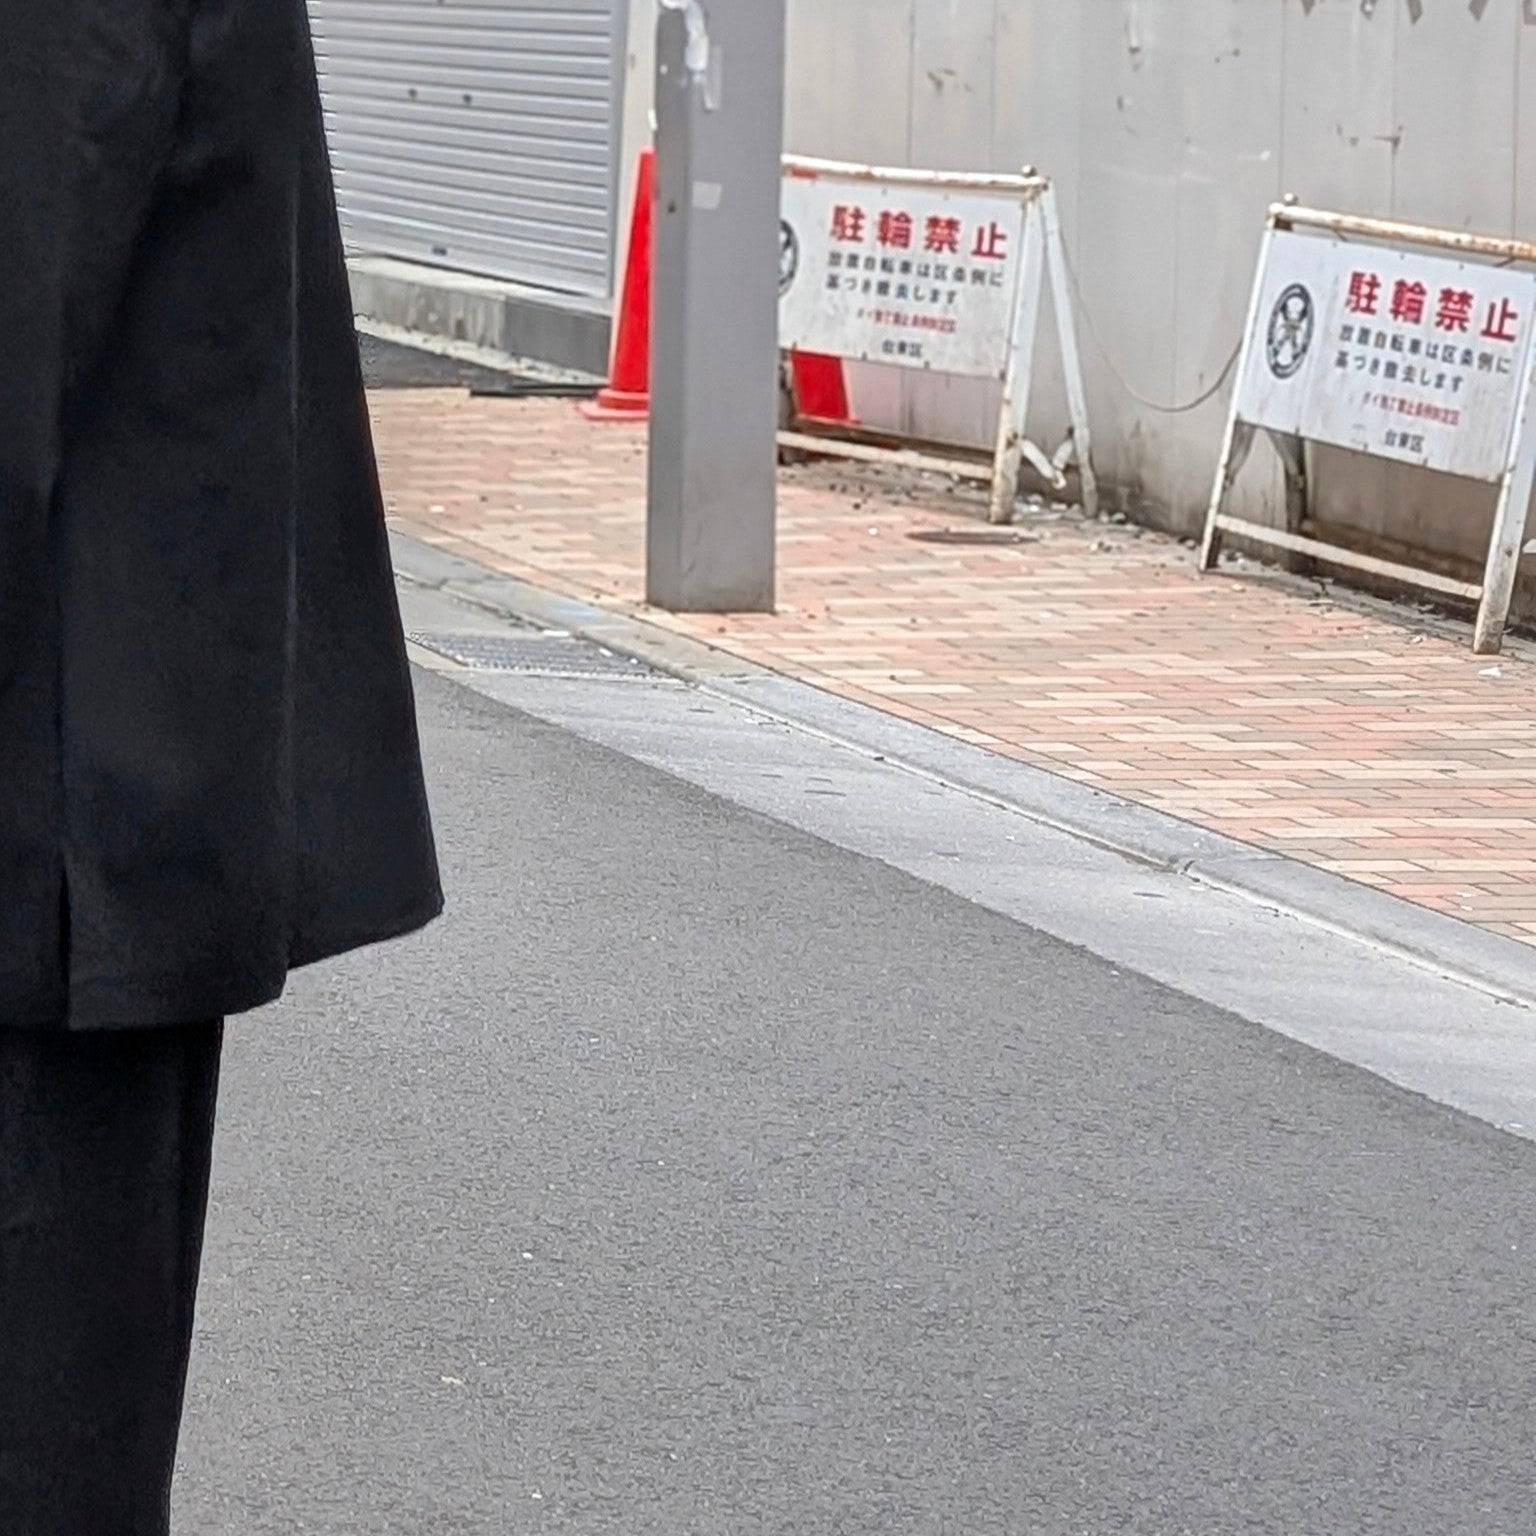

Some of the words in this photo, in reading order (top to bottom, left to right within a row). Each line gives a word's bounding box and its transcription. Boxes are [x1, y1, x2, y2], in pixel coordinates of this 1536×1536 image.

[830, 205, 1007, 260] 駐輪禁止
[1344, 270, 1518, 342] 駐輪禁止
